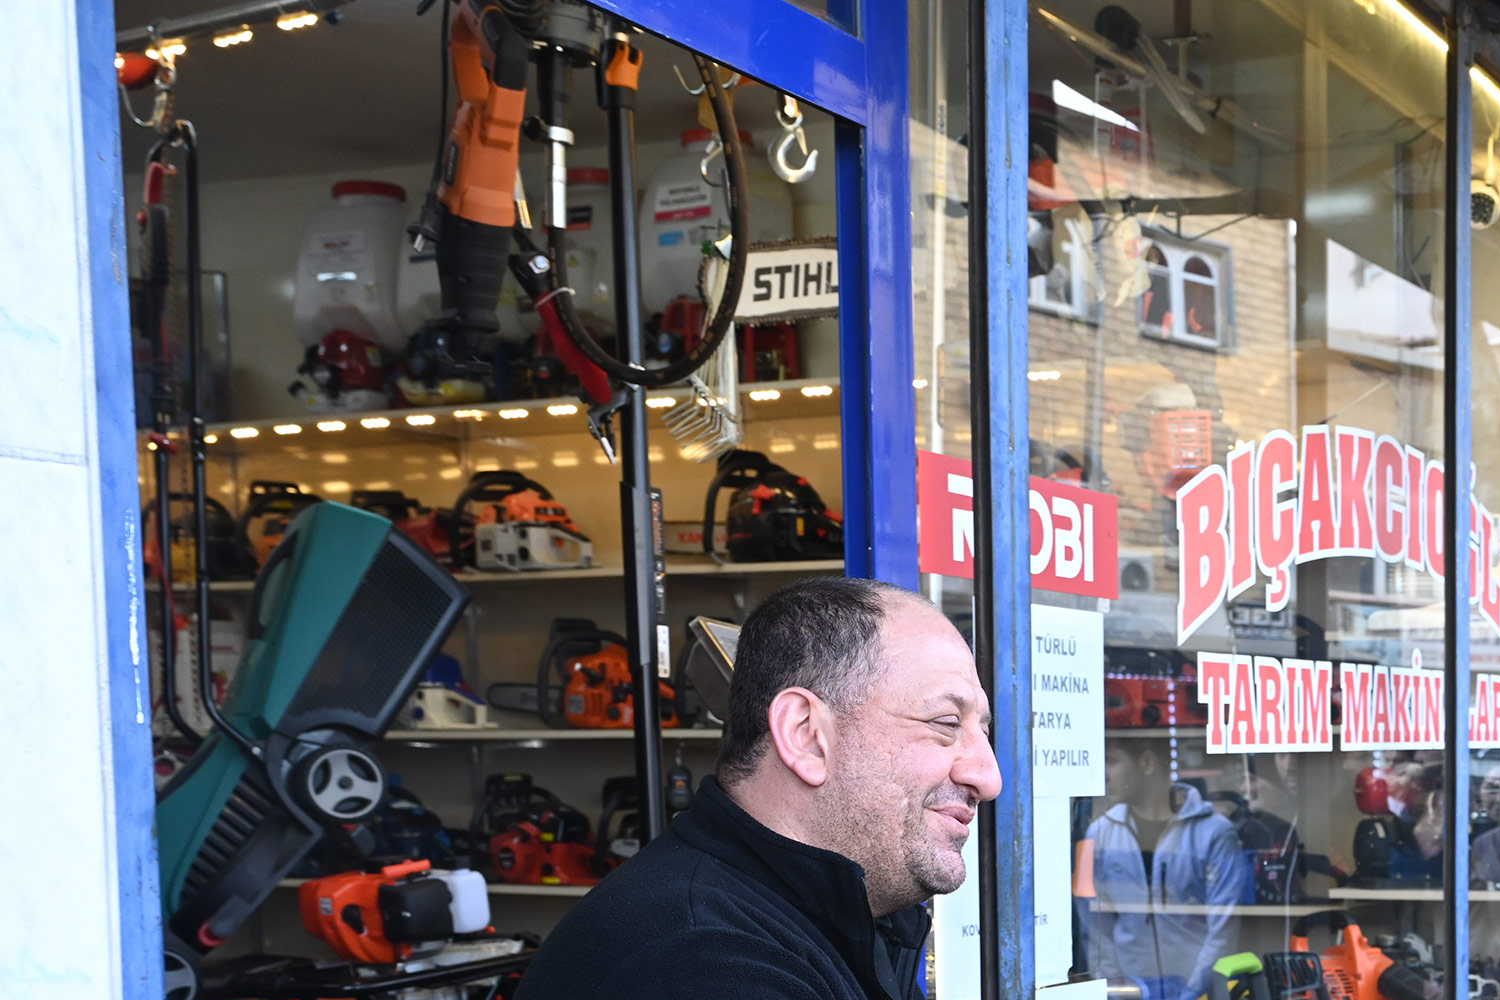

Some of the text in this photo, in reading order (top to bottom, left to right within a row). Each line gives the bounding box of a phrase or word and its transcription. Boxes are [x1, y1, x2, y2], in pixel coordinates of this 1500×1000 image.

[753, 261, 839, 302] STIHL
[1036, 633, 1076, 656] TÜRLÜ
[1041, 673, 1090, 694] MAKİNA
[1198, 652, 1332, 753] TARIM
[1032, 711, 1072, 730] TARYA
[1042, 749, 1090, 767] YAPILIR
